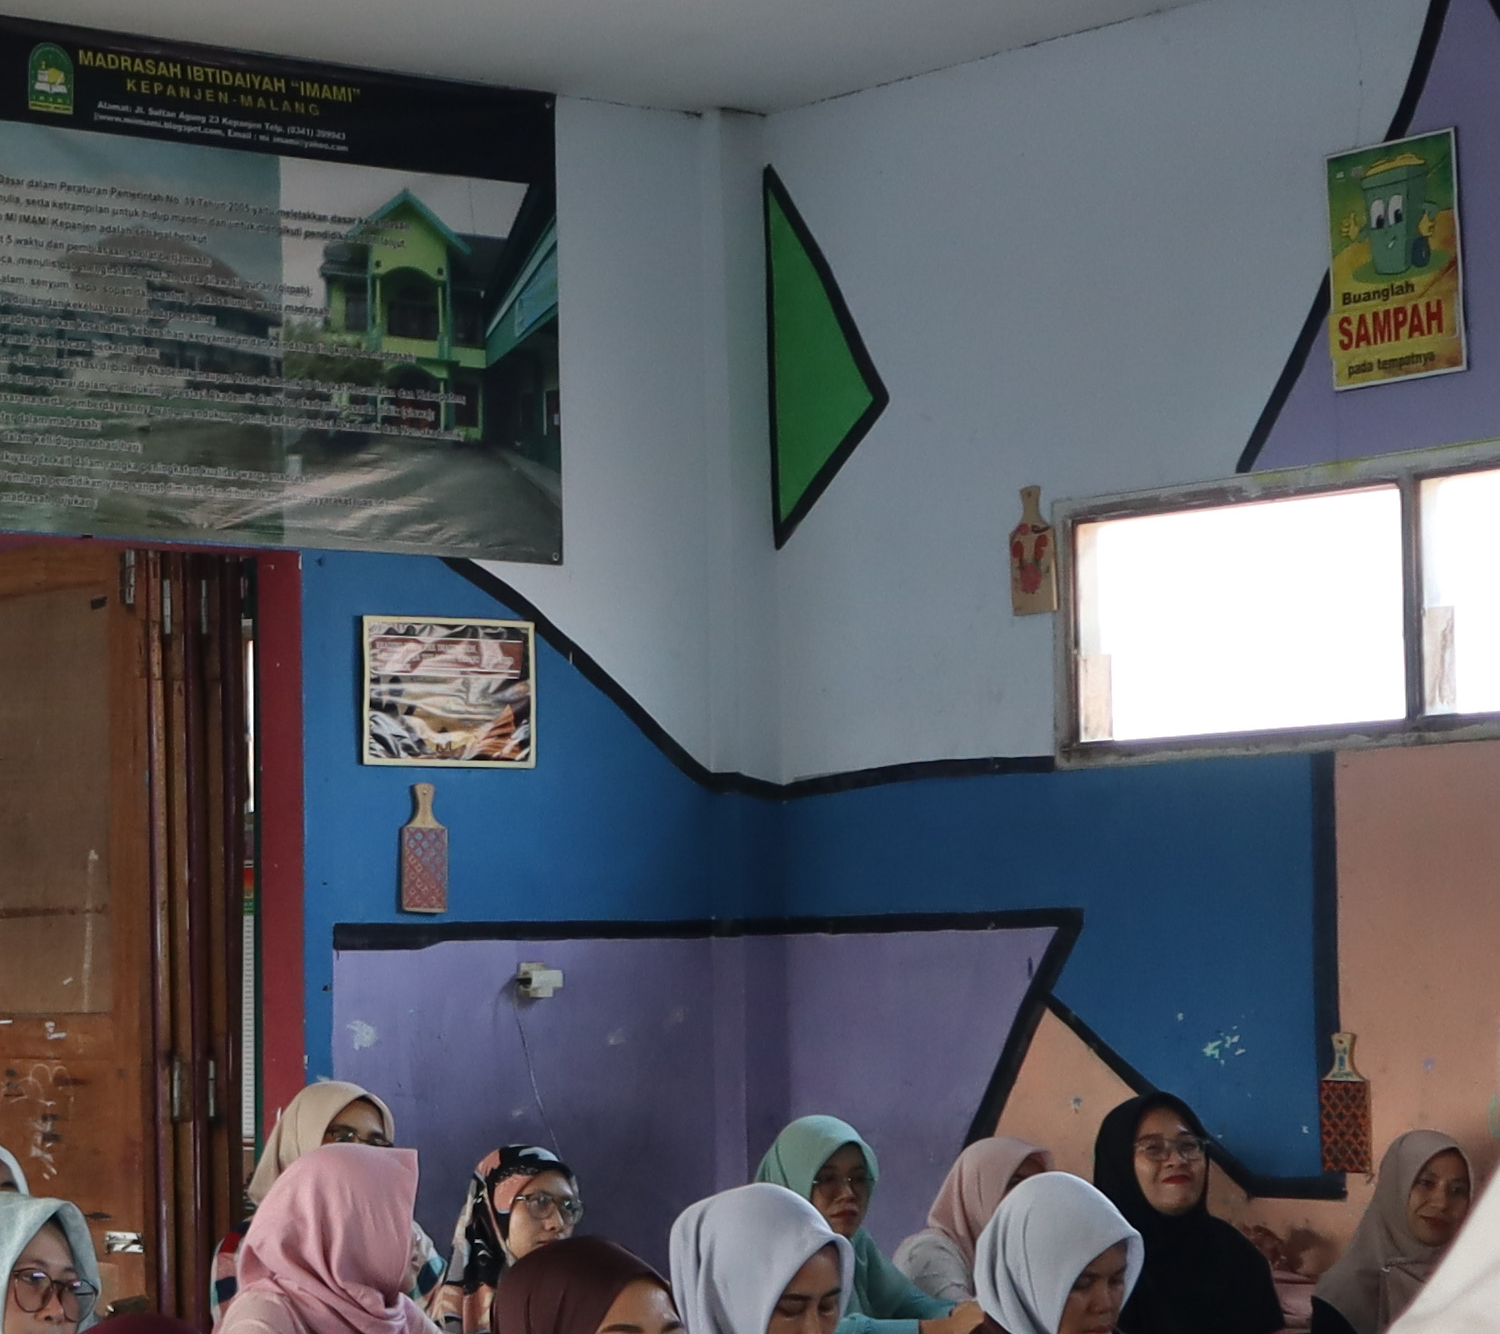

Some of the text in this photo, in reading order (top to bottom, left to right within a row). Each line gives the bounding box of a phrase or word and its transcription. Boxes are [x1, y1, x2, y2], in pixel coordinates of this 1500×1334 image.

[78, 49, 181, 79] MADRASAH
[186, 64, 285, 93] IBTIDAIYAH
[1342, 280, 1415, 305] Buanglah
[1339, 299, 1443, 351] SAMPAH
[1348, 350, 1435, 377] pada tempatnya
